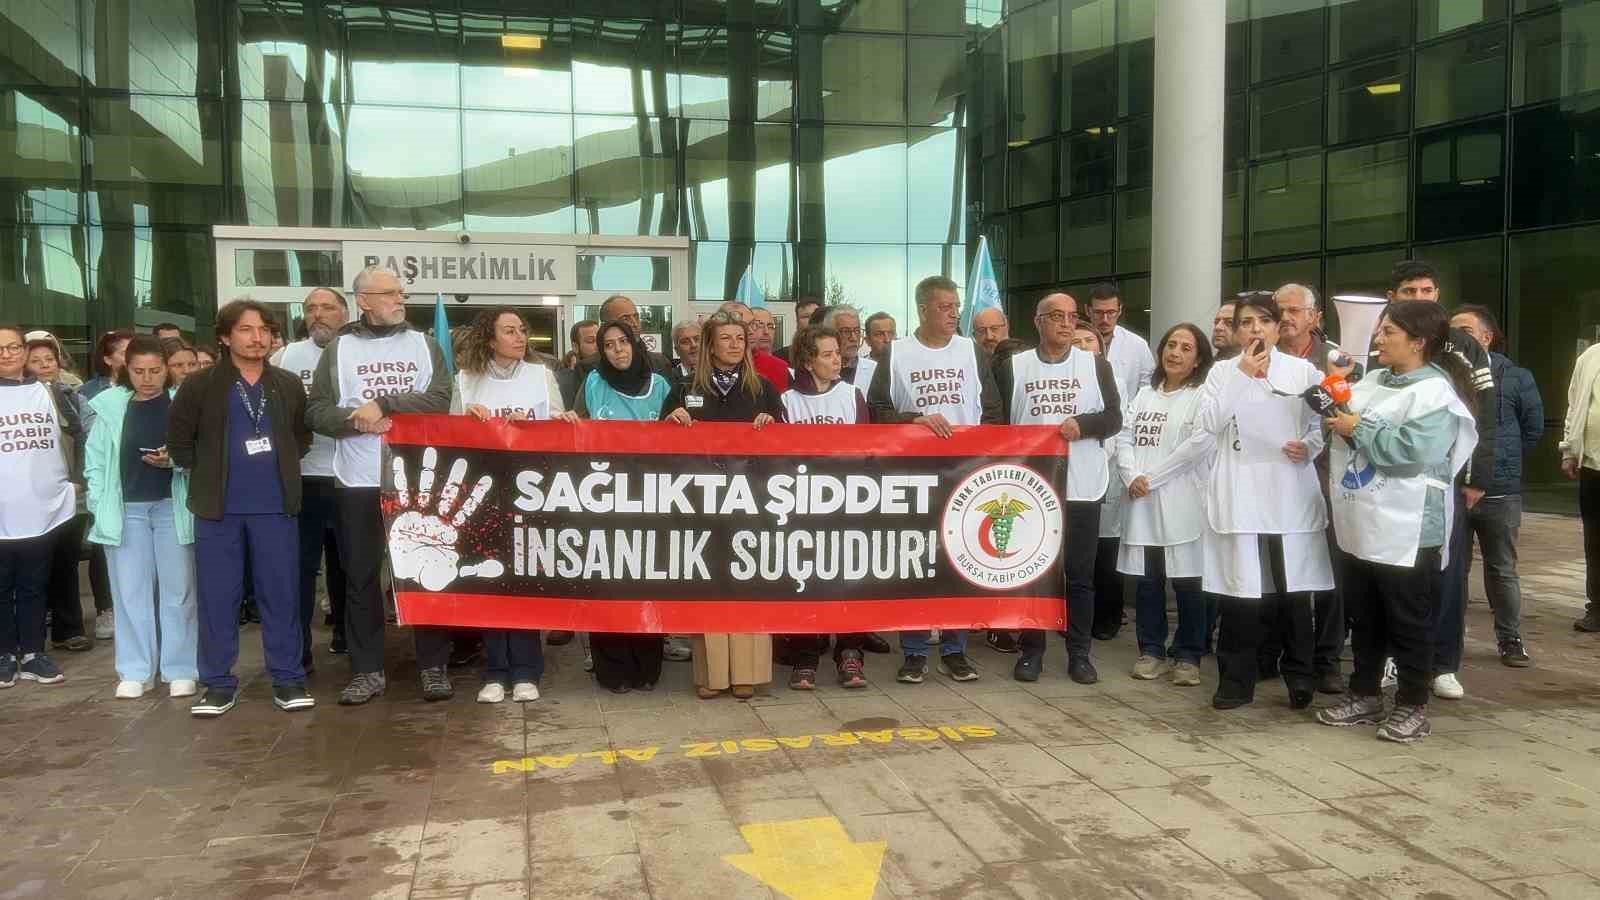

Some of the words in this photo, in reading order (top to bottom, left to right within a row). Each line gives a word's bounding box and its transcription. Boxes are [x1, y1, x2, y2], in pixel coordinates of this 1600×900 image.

[357, 362, 418, 375] BURSA
[910, 368, 964, 383] BURSA
[363, 375, 414, 387] TABİP
[1025, 379, 1081, 393] BURSA
[917, 382, 961, 395] TABİP
[916, 394, 964, 408] ODASI
[1031, 391, 1076, 404] TABİP
[1031, 404, 1077, 416] ODASI
[1, 425, 52, 440] TABİP
[1, 440, 54, 453] ODASI
[513, 461, 758, 514] SAĞLIKTA
[765, 464, 939, 525] ŞİDDET
[952, 486, 974, 512] TÜRK
[973, 469, 1025, 487] TABİPLERİ
[513, 515, 712, 580] İNSANLIK
[730, 530, 937, 592] SUÇUDUR!
[957, 553, 984, 580] BURSA
[987, 572, 1016, 584] TABİP
[1017, 552, 1049, 579] ODASI
[494, 747, 659, 774] ALAN
